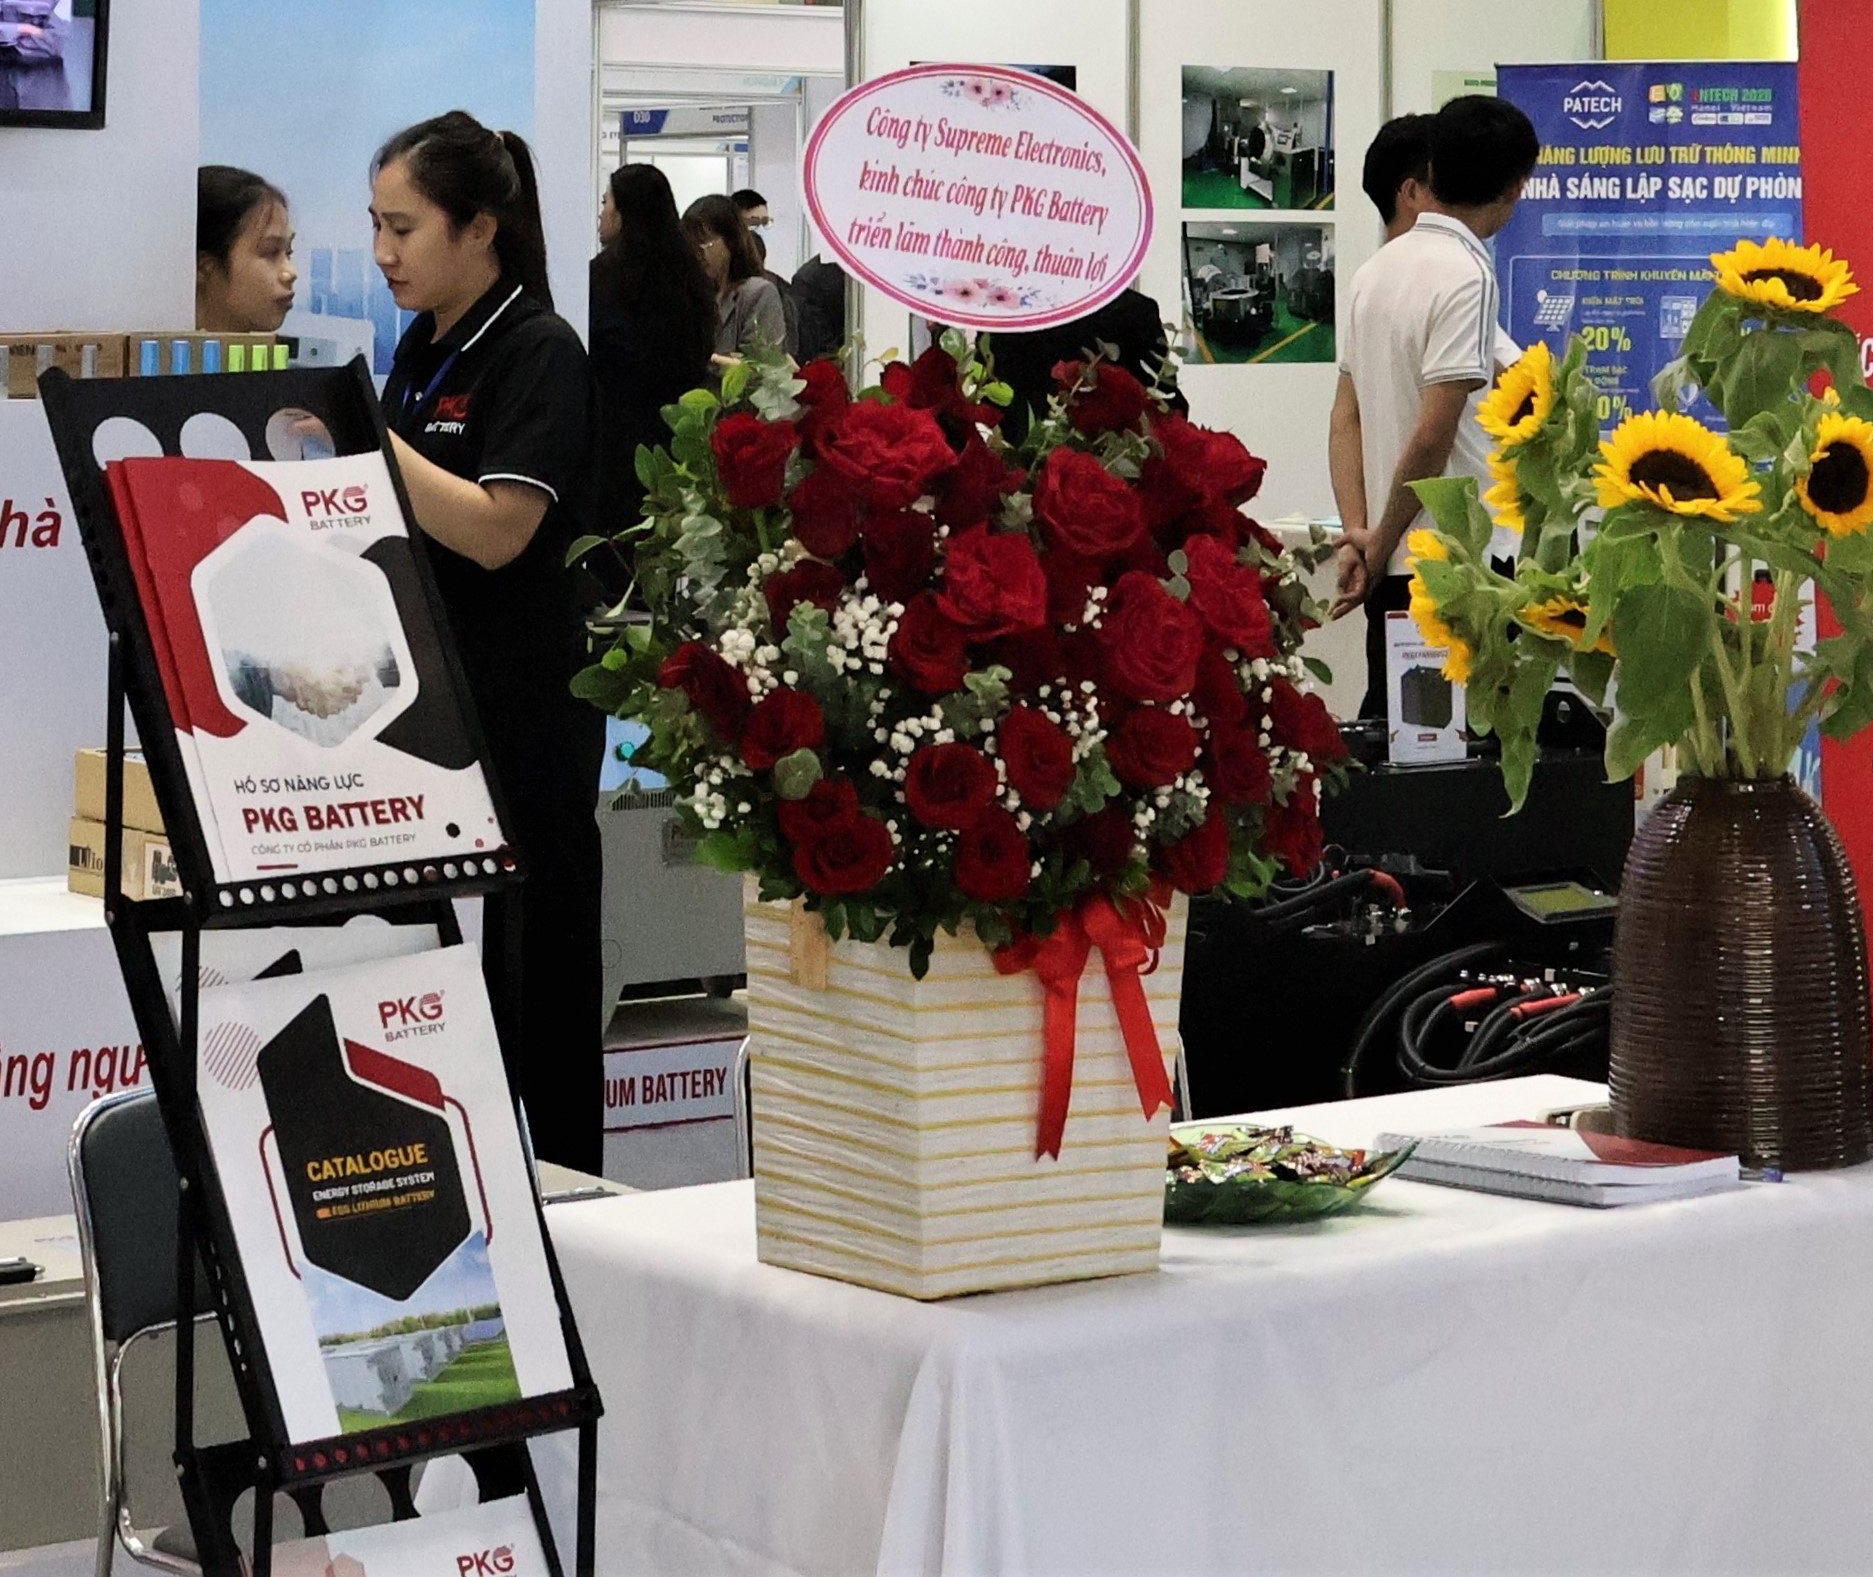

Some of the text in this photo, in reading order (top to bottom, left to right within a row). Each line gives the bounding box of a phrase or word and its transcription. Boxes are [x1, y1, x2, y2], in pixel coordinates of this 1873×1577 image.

[1564, 96, 1622, 112] PATECH
[867, 106, 1106, 176] Công ty Supreme Electronics,
[947, 176, 1108, 234] công ty PKG Battery
[1566, 172, 1708, 204] SÁNG LẬP SẠC
[1583, 326, 1631, 352] 20%
[301, 486, 368, 516] PKG
[310, 516, 370, 530] BATTERY
[242, 795, 425, 833] PKG BATTERY
[642, 1067, 726, 1104] BATTERY
[307, 1143, 428, 1181] CATALOGUE
